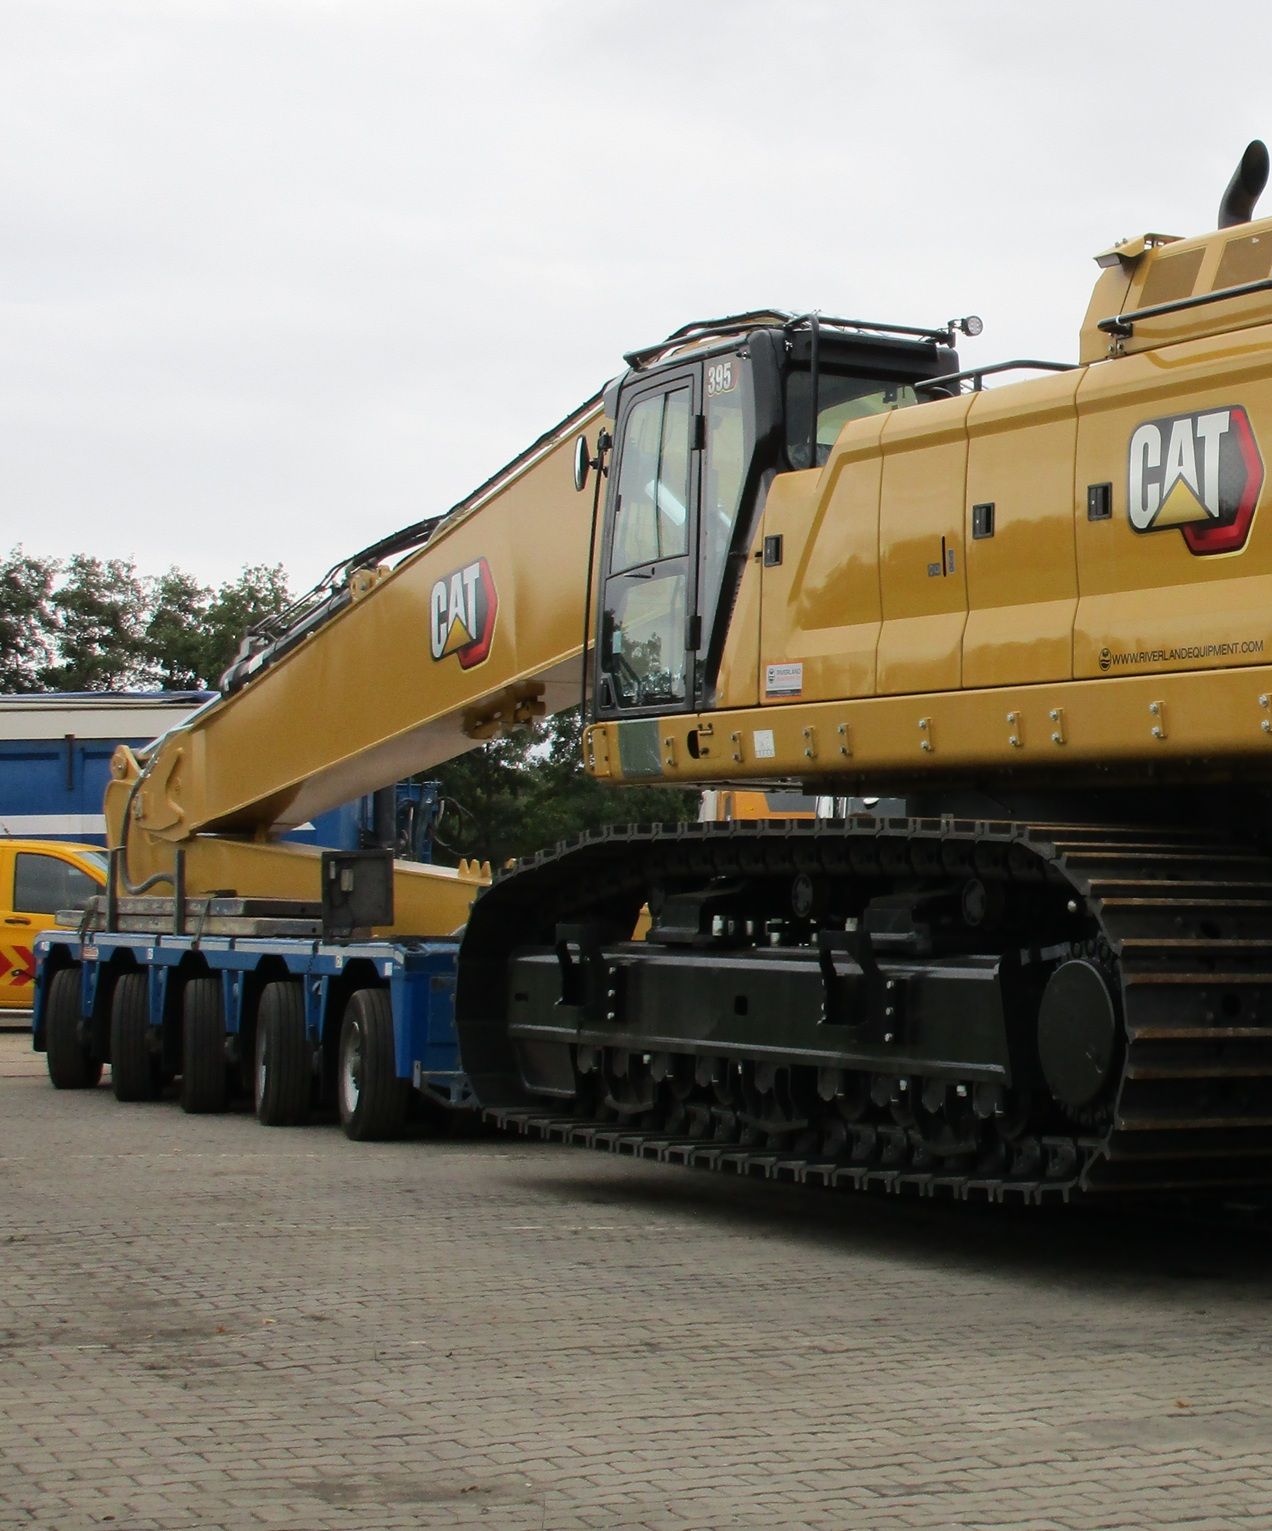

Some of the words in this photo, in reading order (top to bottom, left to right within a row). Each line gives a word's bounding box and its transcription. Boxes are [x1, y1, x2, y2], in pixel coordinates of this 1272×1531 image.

[707, 362, 732, 394] 395
[1129, 410, 1231, 529] CAT
[431, 562, 480, 658] CAT
[1112, 640, 1265, 666] WWW.RIVERLANDEQUIPMENT.COM
